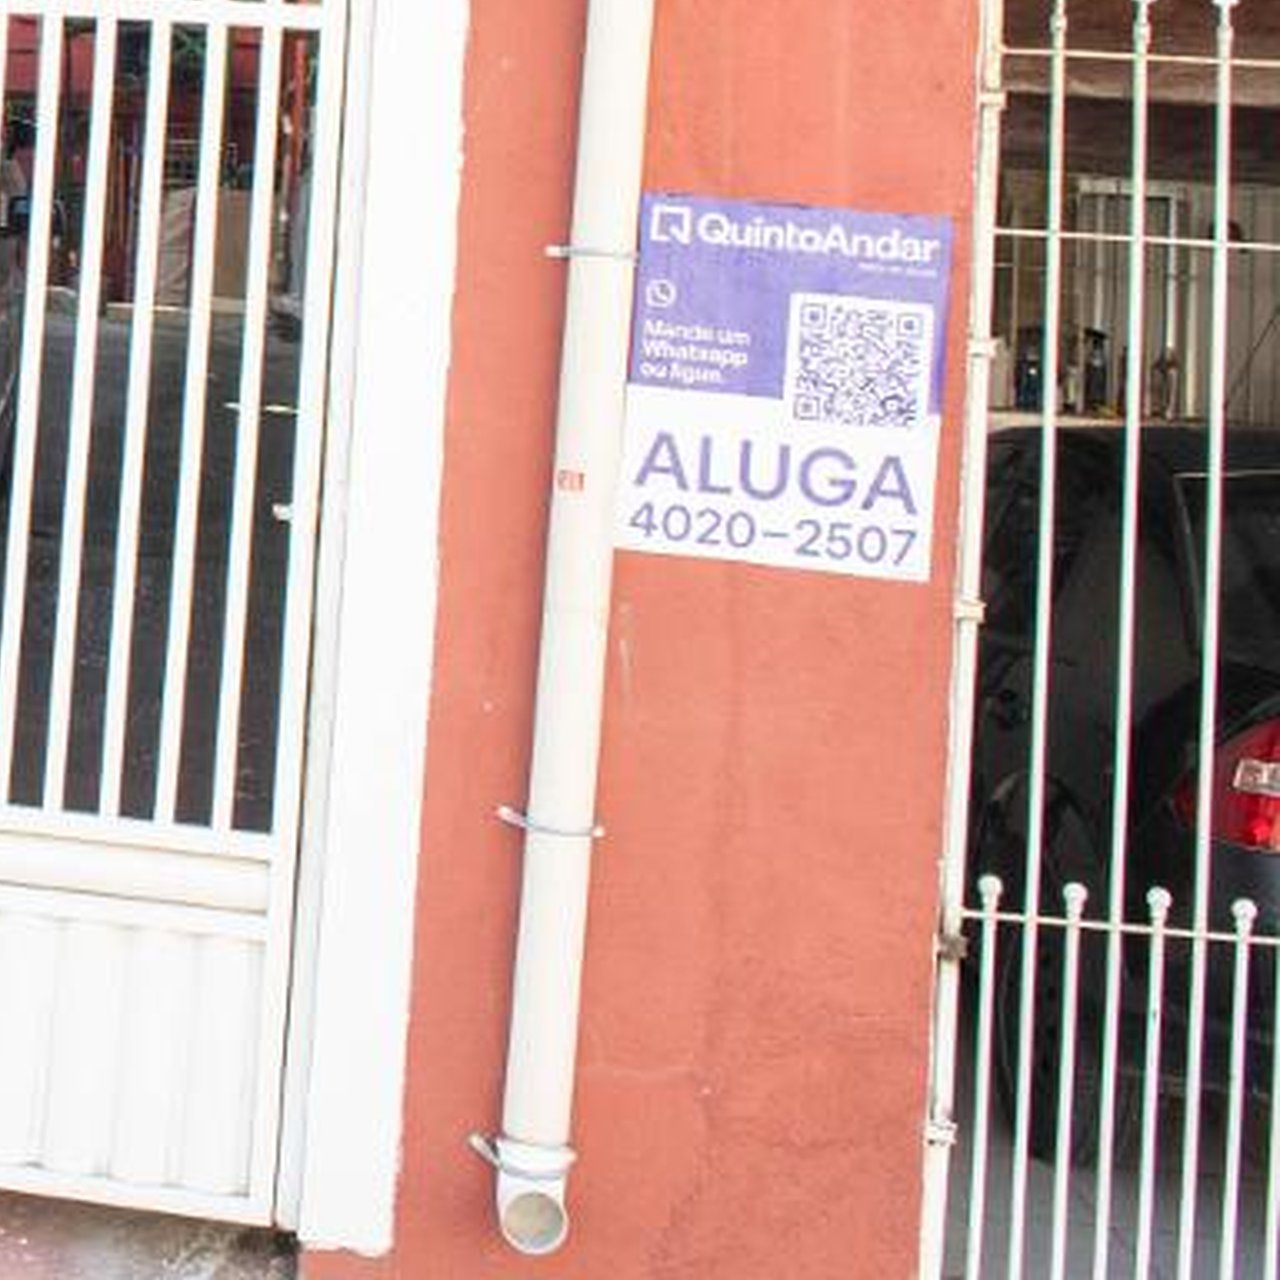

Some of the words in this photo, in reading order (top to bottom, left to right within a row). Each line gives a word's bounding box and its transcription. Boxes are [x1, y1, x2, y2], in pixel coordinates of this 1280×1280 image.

[697, 212, 941, 262] QuintoAndar
[633, 431, 919, 516] ALUGA
[628, 501, 919, 567] 4020-2507
